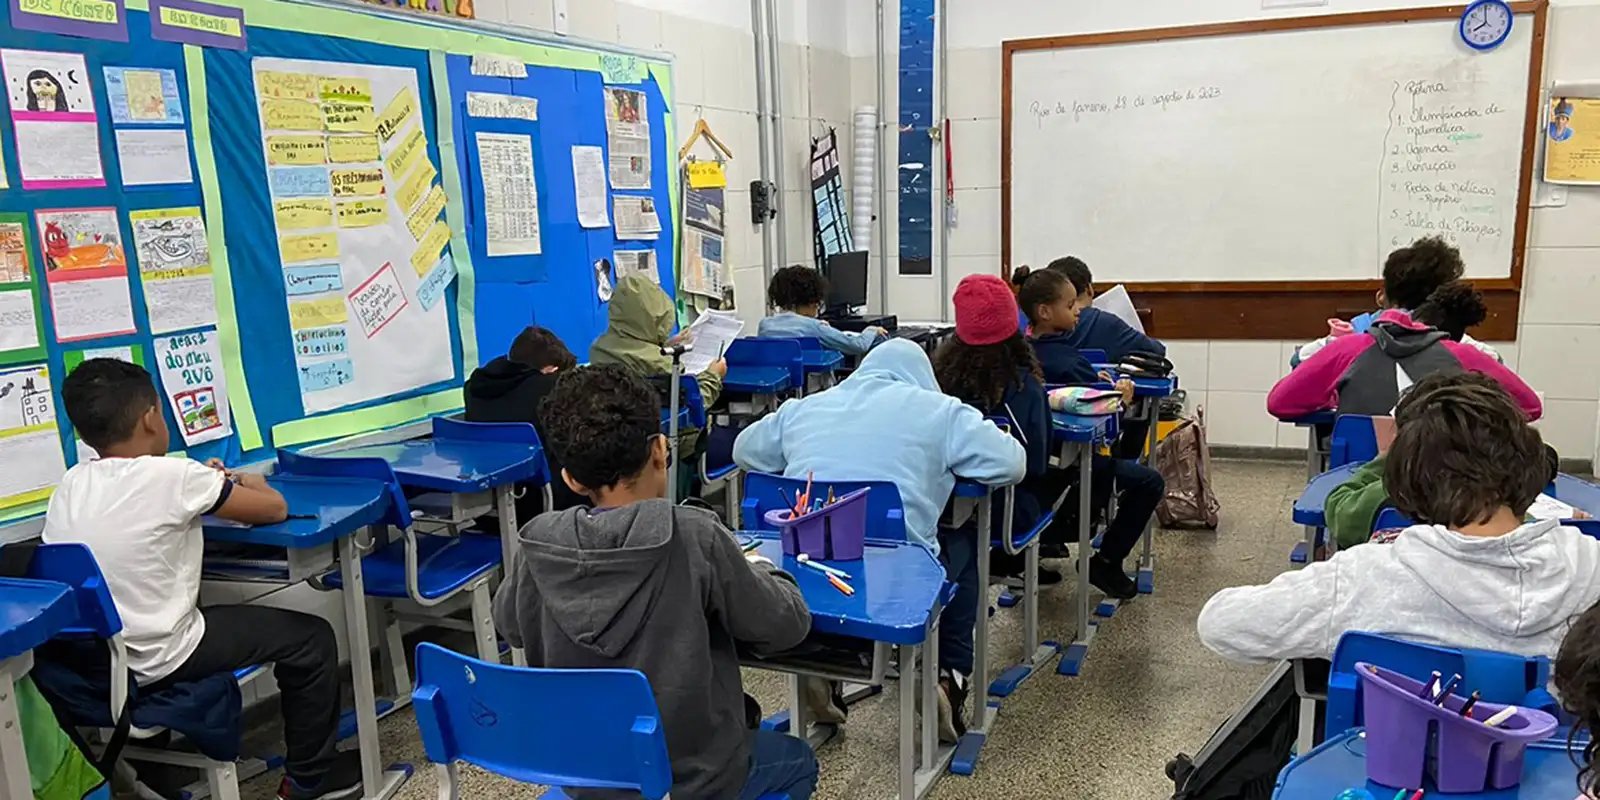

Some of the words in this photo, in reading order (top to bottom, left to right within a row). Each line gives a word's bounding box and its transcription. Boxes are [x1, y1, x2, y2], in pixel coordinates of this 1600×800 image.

[1055, 101, 1066, 114] de
[1134, 94, 1145, 108] de
[1484, 103, 1505, 116] de
[1434, 182, 1446, 193] de
